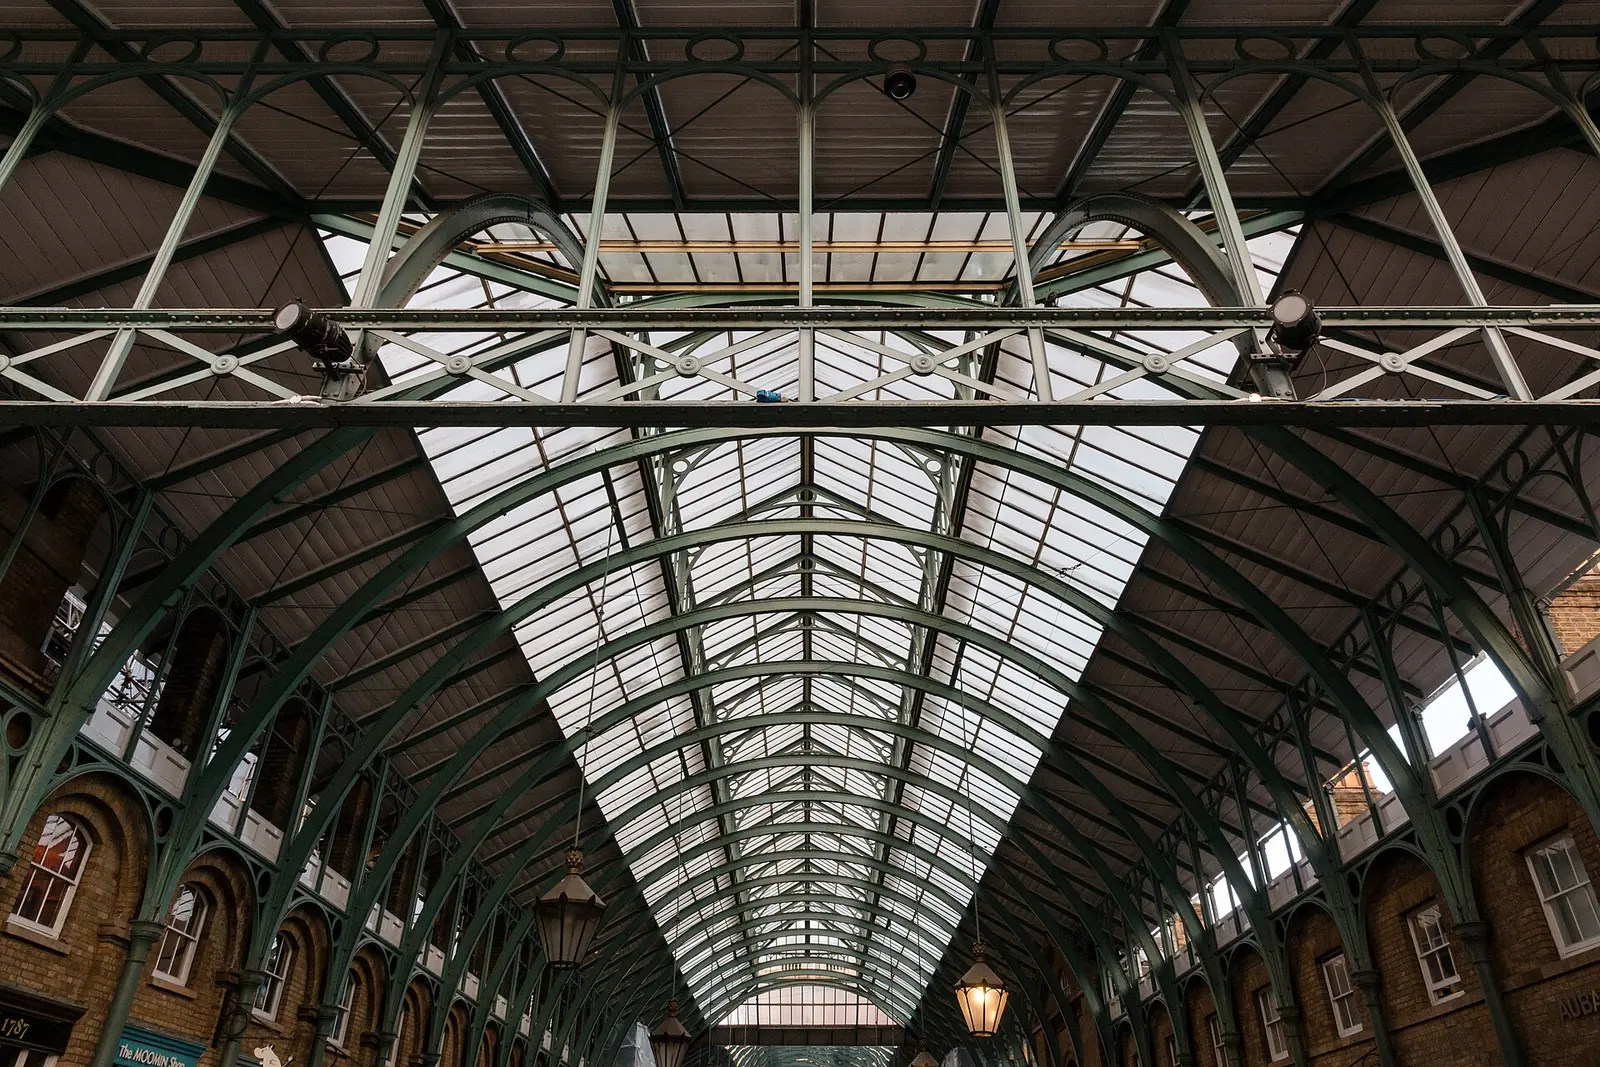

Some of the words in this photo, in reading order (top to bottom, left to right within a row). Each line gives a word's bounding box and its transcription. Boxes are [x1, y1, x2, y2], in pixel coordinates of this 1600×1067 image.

[1, 1018, 30, 1040] 1787
[119, 1044, 133, 1060] The
[132, 1048, 170, 1067] MOOMIN
